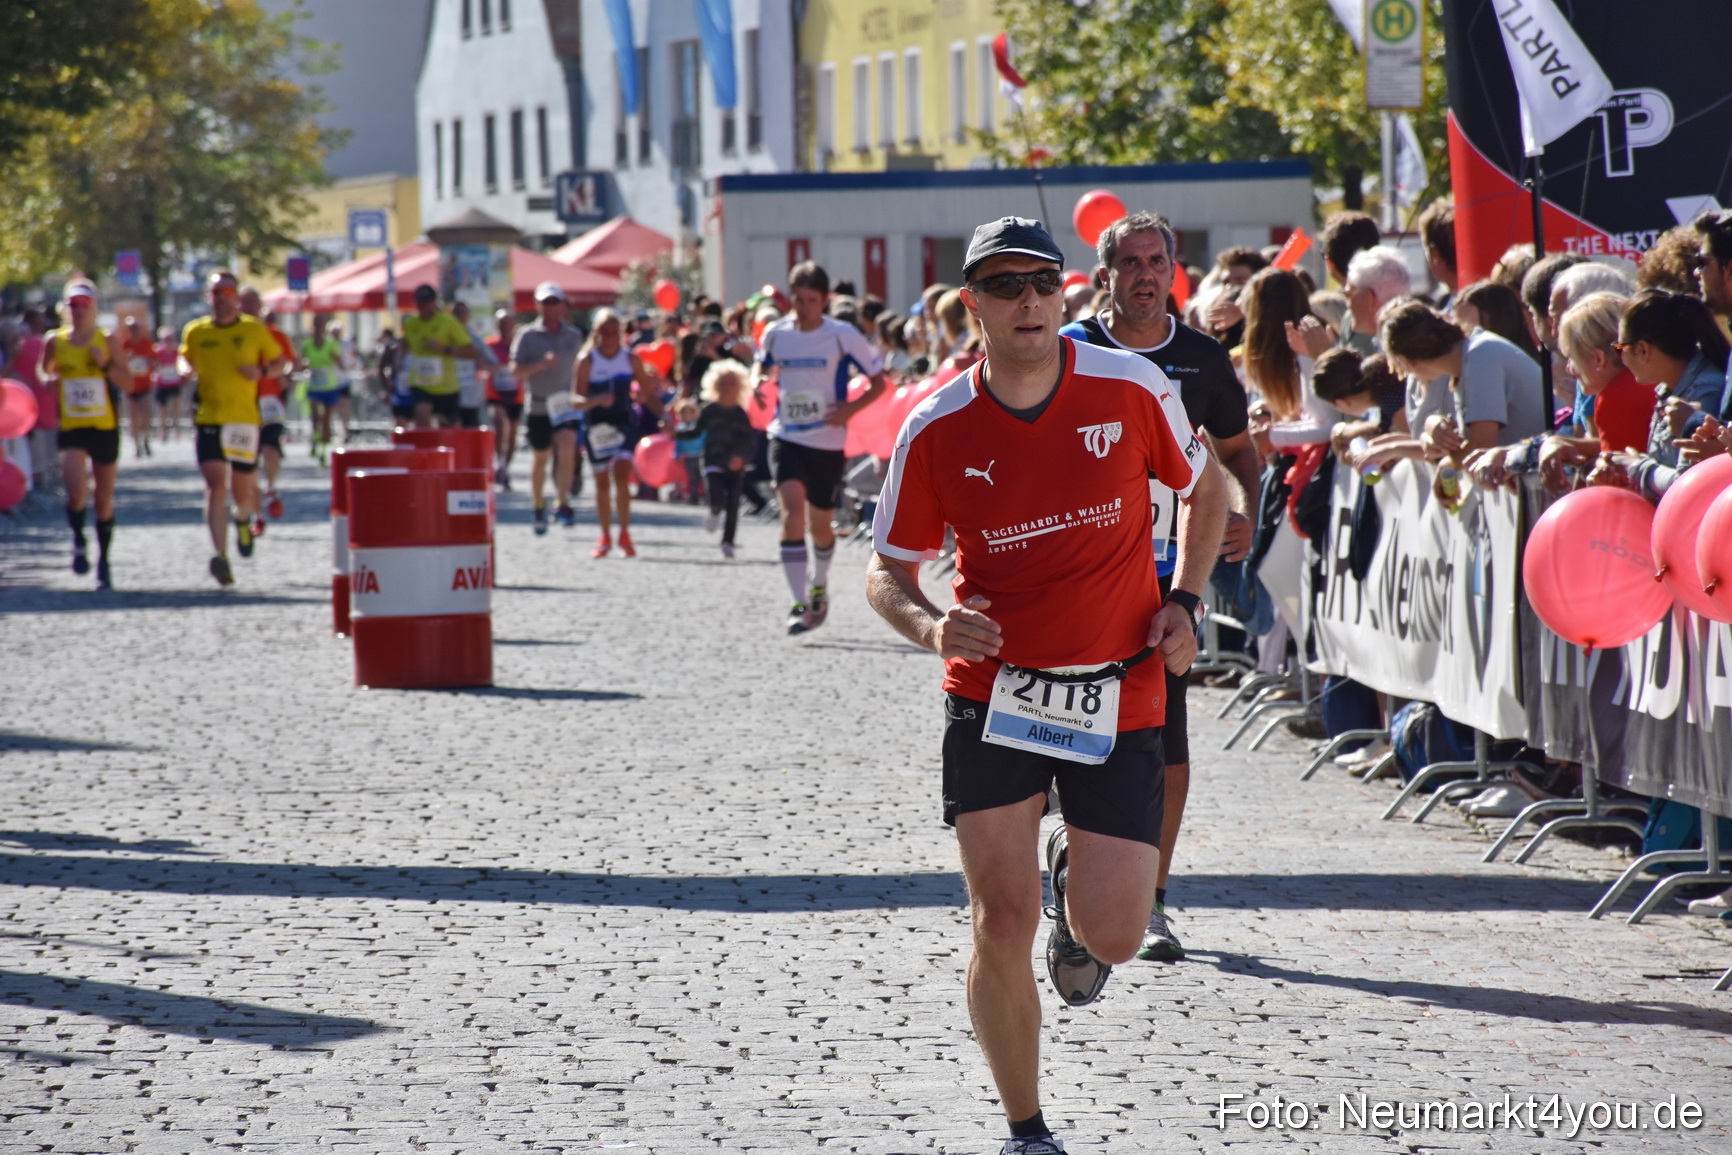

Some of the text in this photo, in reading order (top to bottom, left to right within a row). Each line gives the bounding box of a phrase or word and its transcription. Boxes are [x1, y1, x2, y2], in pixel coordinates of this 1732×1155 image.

[1498, 0, 1581, 99] PARTL
[1563, 229, 1659, 254] THE NEXT
[981, 497, 1122, 540] ENGELHARDT & WALTER
[1067, 519, 1081, 528] DAS
[1097, 515, 1121, 529] Lauf
[988, 541, 1028, 554] Amberg
[1018, 704, 1082, 726] PARTL Neumarkt
[1027, 724, 1075, 748] Albert
